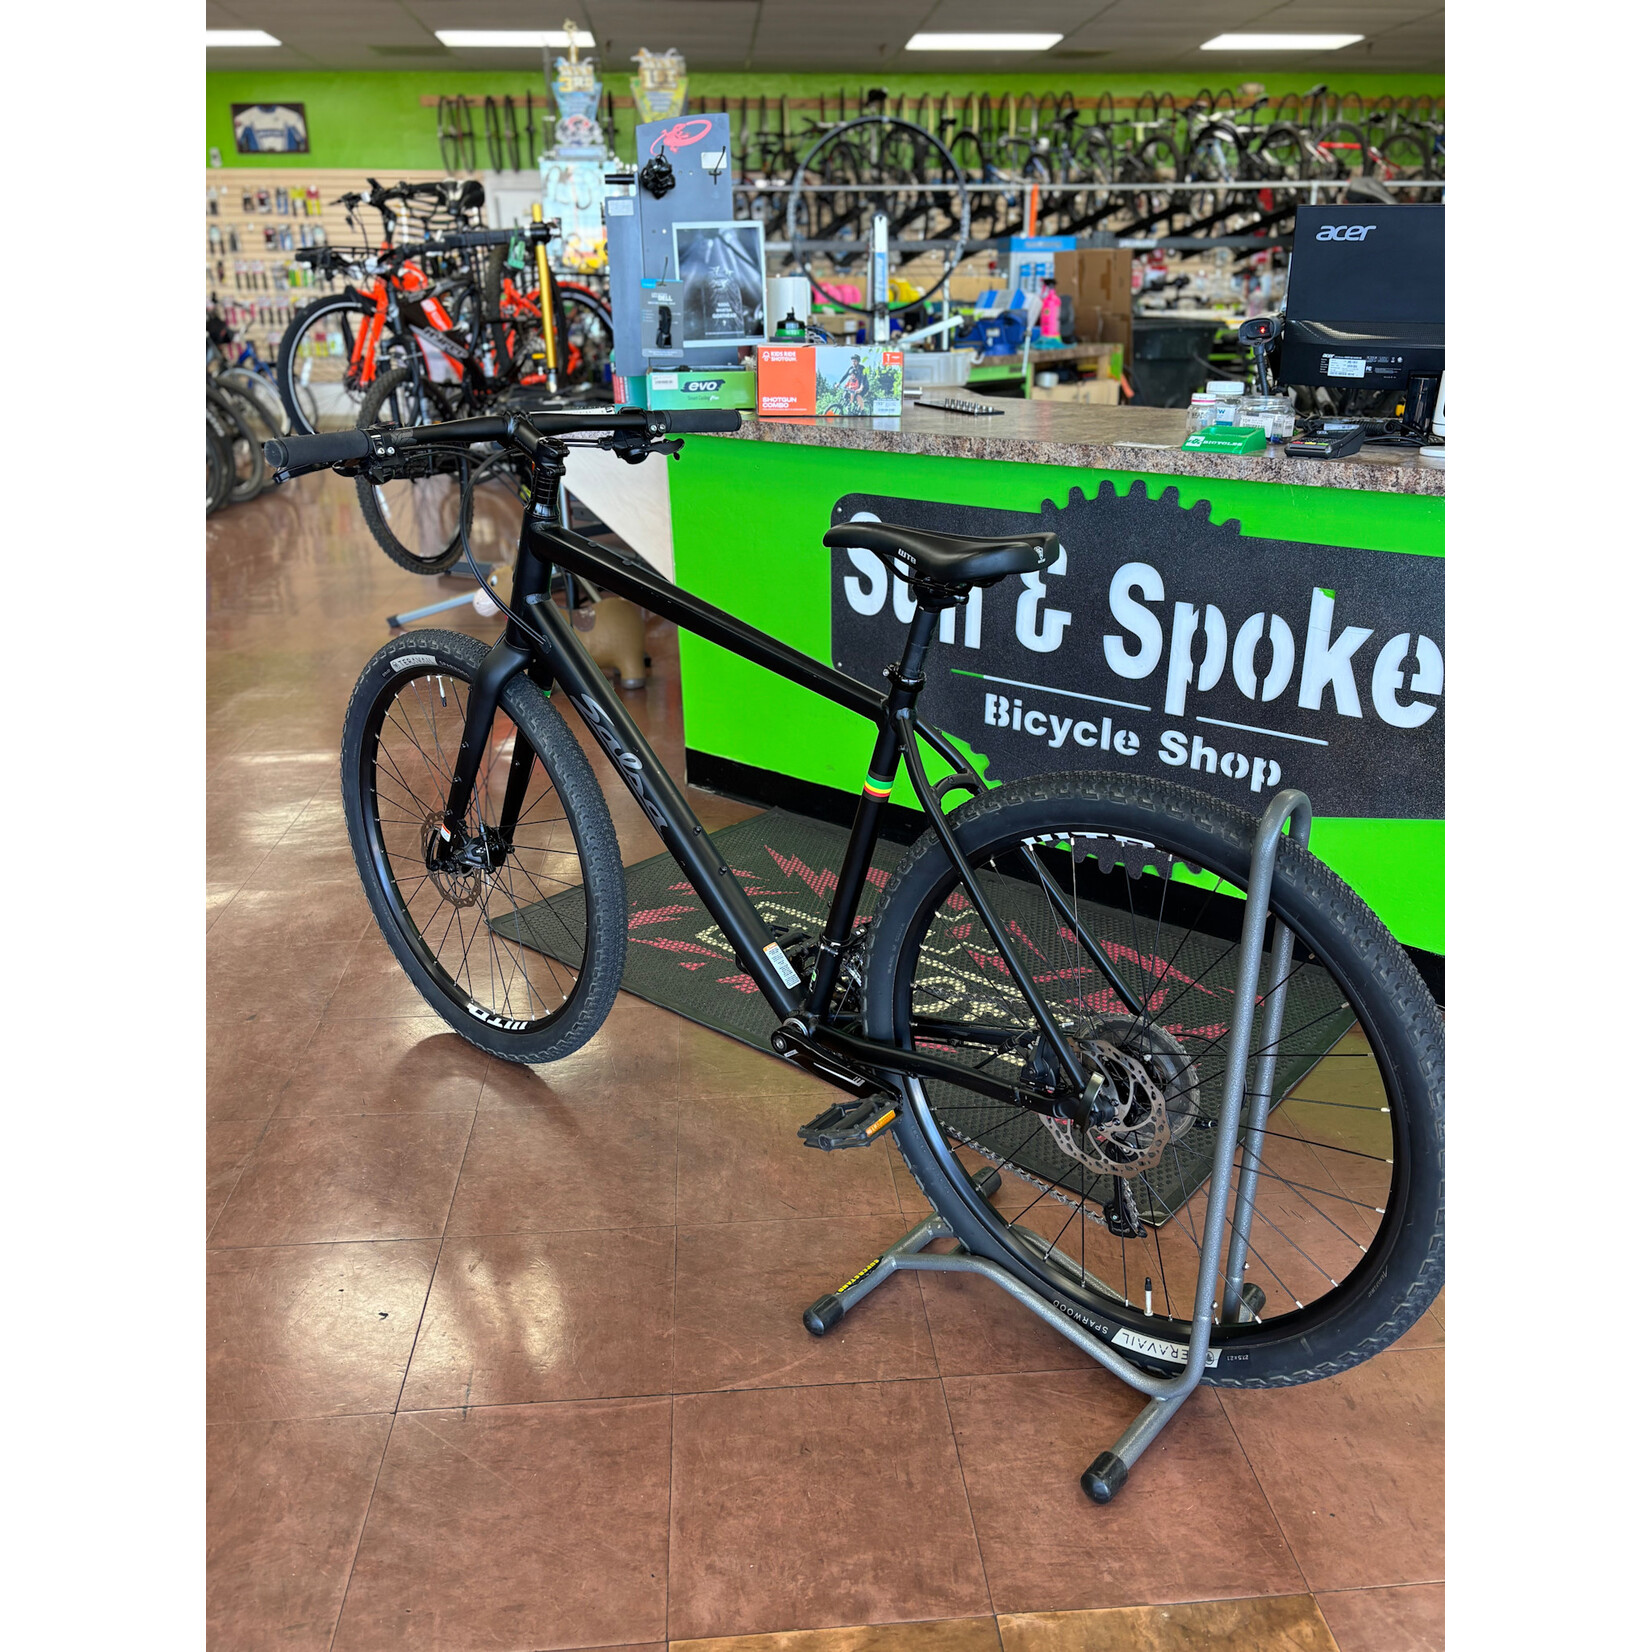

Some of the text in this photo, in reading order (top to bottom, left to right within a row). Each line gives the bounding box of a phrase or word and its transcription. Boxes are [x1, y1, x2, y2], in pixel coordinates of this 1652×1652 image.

[1316, 225, 1377, 241] acer
[688, 381, 717, 391] evo
[898, 548, 917, 565] WTB
[1103, 562, 1444, 728] Spoke
[984, 693, 1281, 793] Bicycle Shop
[1052, 1299, 1108, 1335] SPARWOOD
[1121, 1331, 1189, 1361] ERAVAIL
